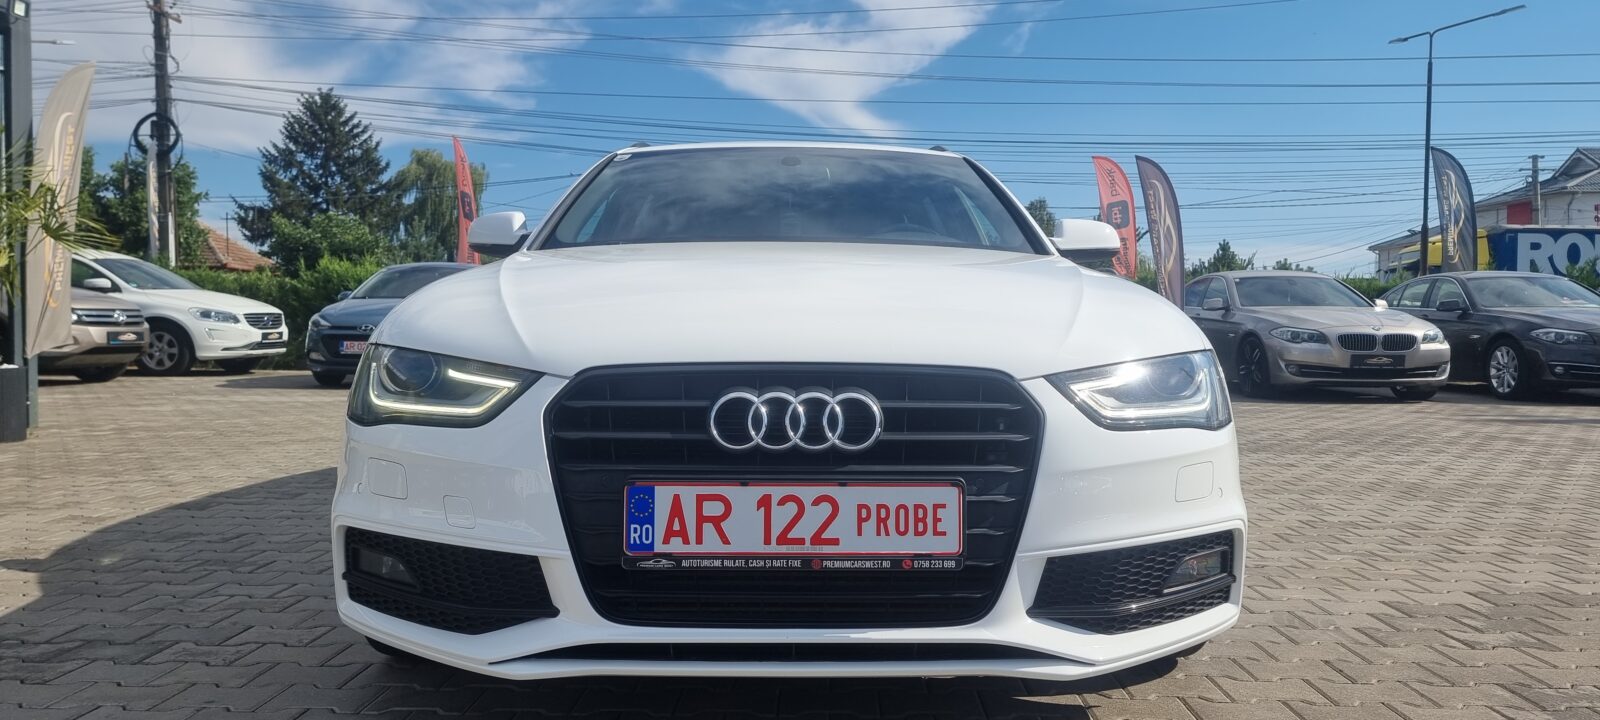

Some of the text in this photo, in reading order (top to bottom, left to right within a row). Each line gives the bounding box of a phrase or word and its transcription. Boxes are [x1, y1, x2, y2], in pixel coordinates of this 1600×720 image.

[1517, 232, 1600, 276] RO
[345, 342, 356, 351] AR
[662, 493, 948, 547] AR 122 PROBE
[630, 524, 653, 545] RO
[681, 559, 723, 568] AUTOTURISME
[724, 559, 748, 569] RULATE,
[748, 559, 765, 568] CASH
[772, 559, 788, 568] RATE
[788, 559, 802, 568] FIXE
[822, 560, 891, 568] PREMIUMCARSWEST.RO
[914, 560, 930, 568] 0758
[930, 560, 943, 568] 233
[943, 560, 956, 568] 699
